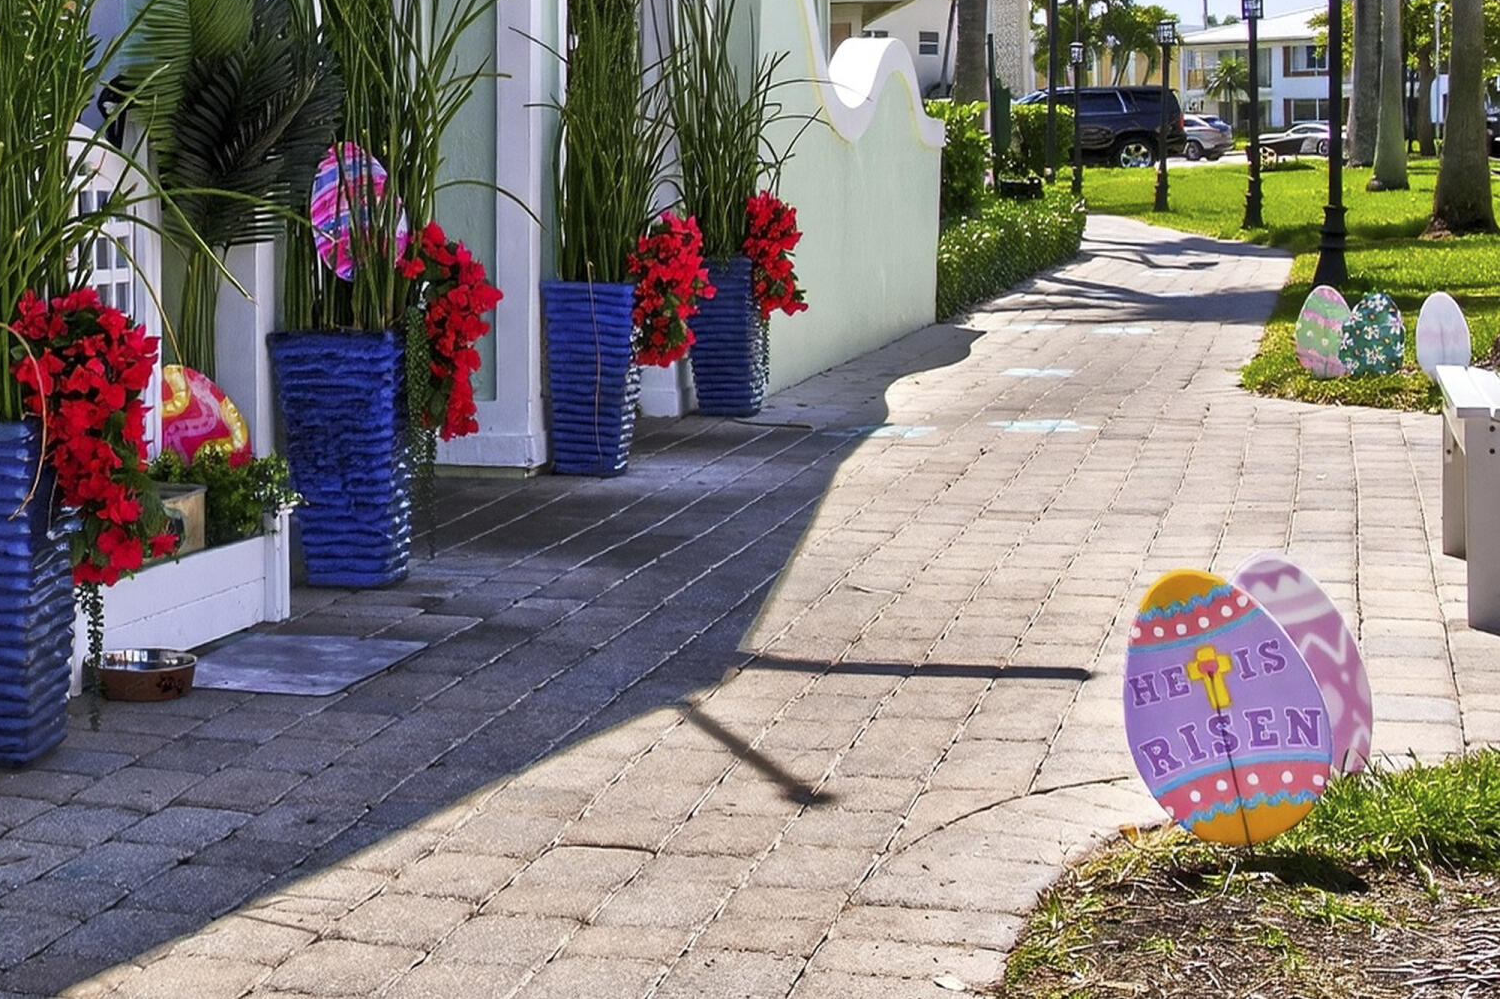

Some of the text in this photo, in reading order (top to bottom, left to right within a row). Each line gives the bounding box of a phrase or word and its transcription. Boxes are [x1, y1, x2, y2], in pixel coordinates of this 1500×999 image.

[1127, 639, 1288, 707] HE IS
[1137, 706, 1323, 778] RISEN
